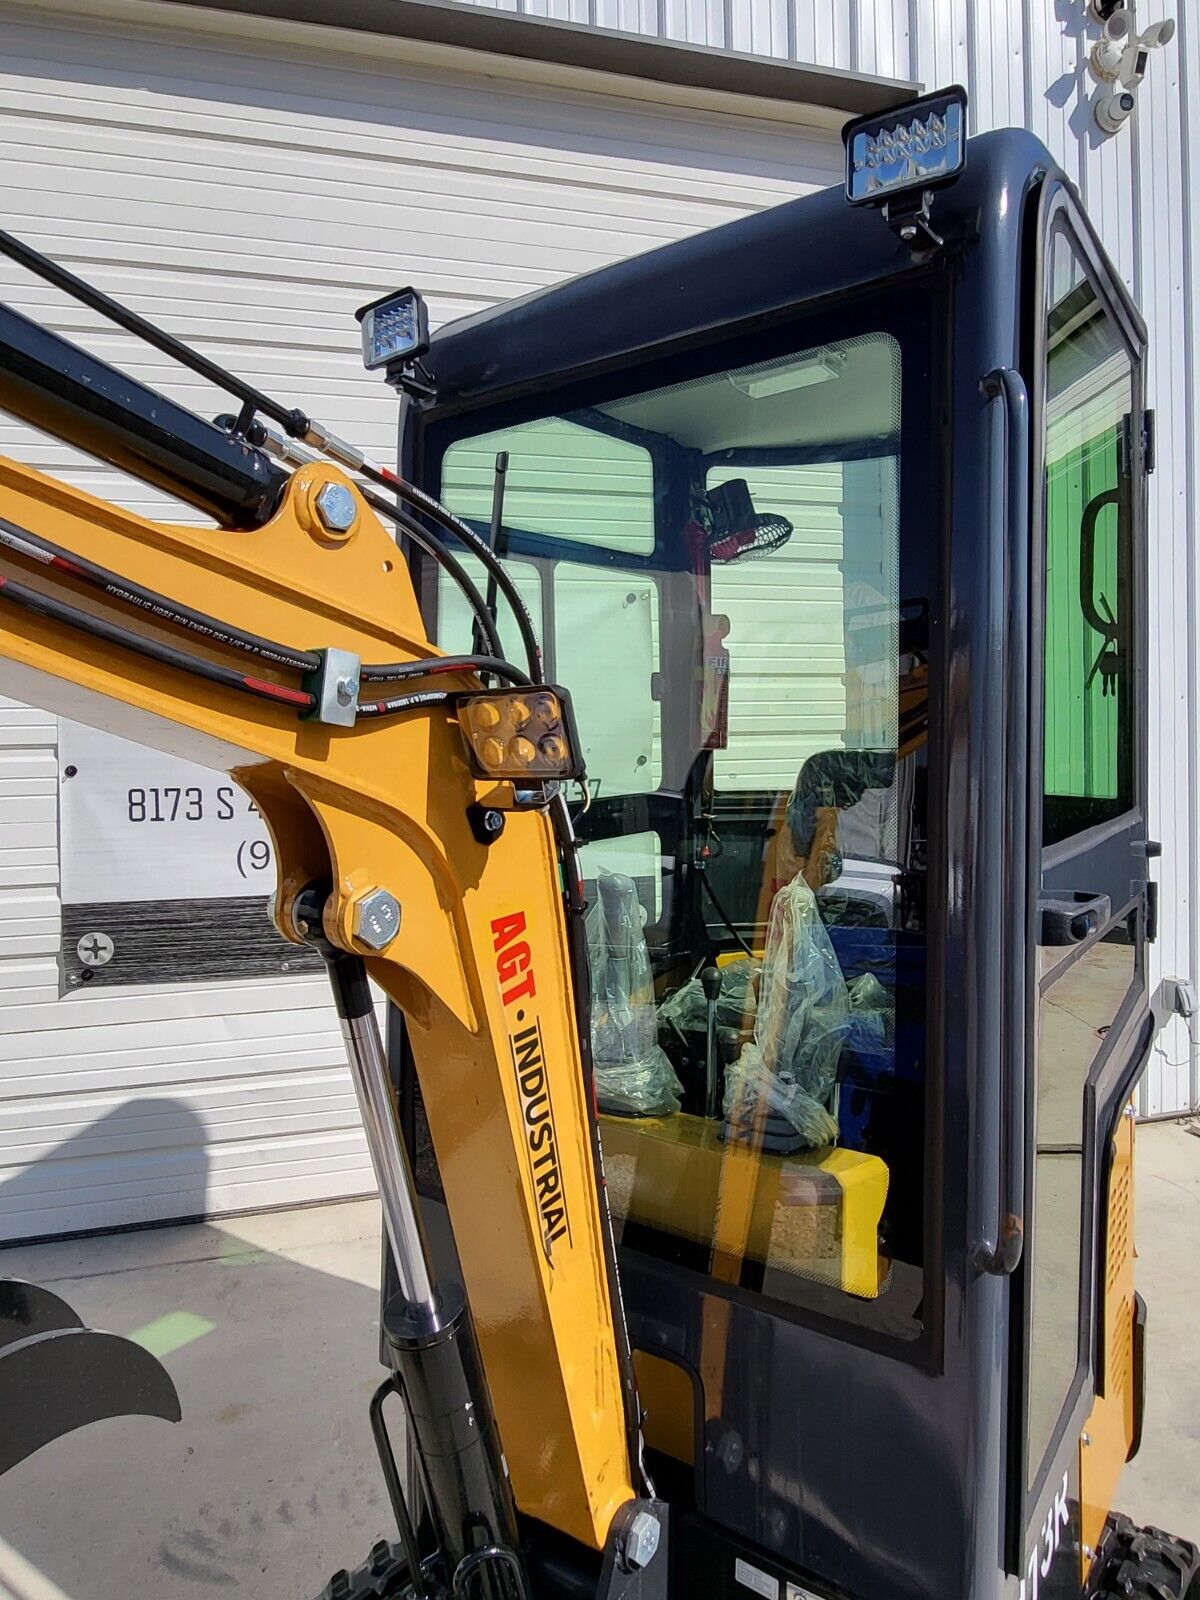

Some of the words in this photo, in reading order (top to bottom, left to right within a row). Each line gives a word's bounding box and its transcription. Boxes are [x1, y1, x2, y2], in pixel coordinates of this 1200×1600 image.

[106, 584, 152, 609] HYDRAULIC
[151, 605, 175, 619] HOSE
[128, 787, 203, 822] 8173
[216, 787, 234, 820] S
[490, 910, 537, 1007] AGT
[513, 1024, 568, 1257] INDUSTRIAL
